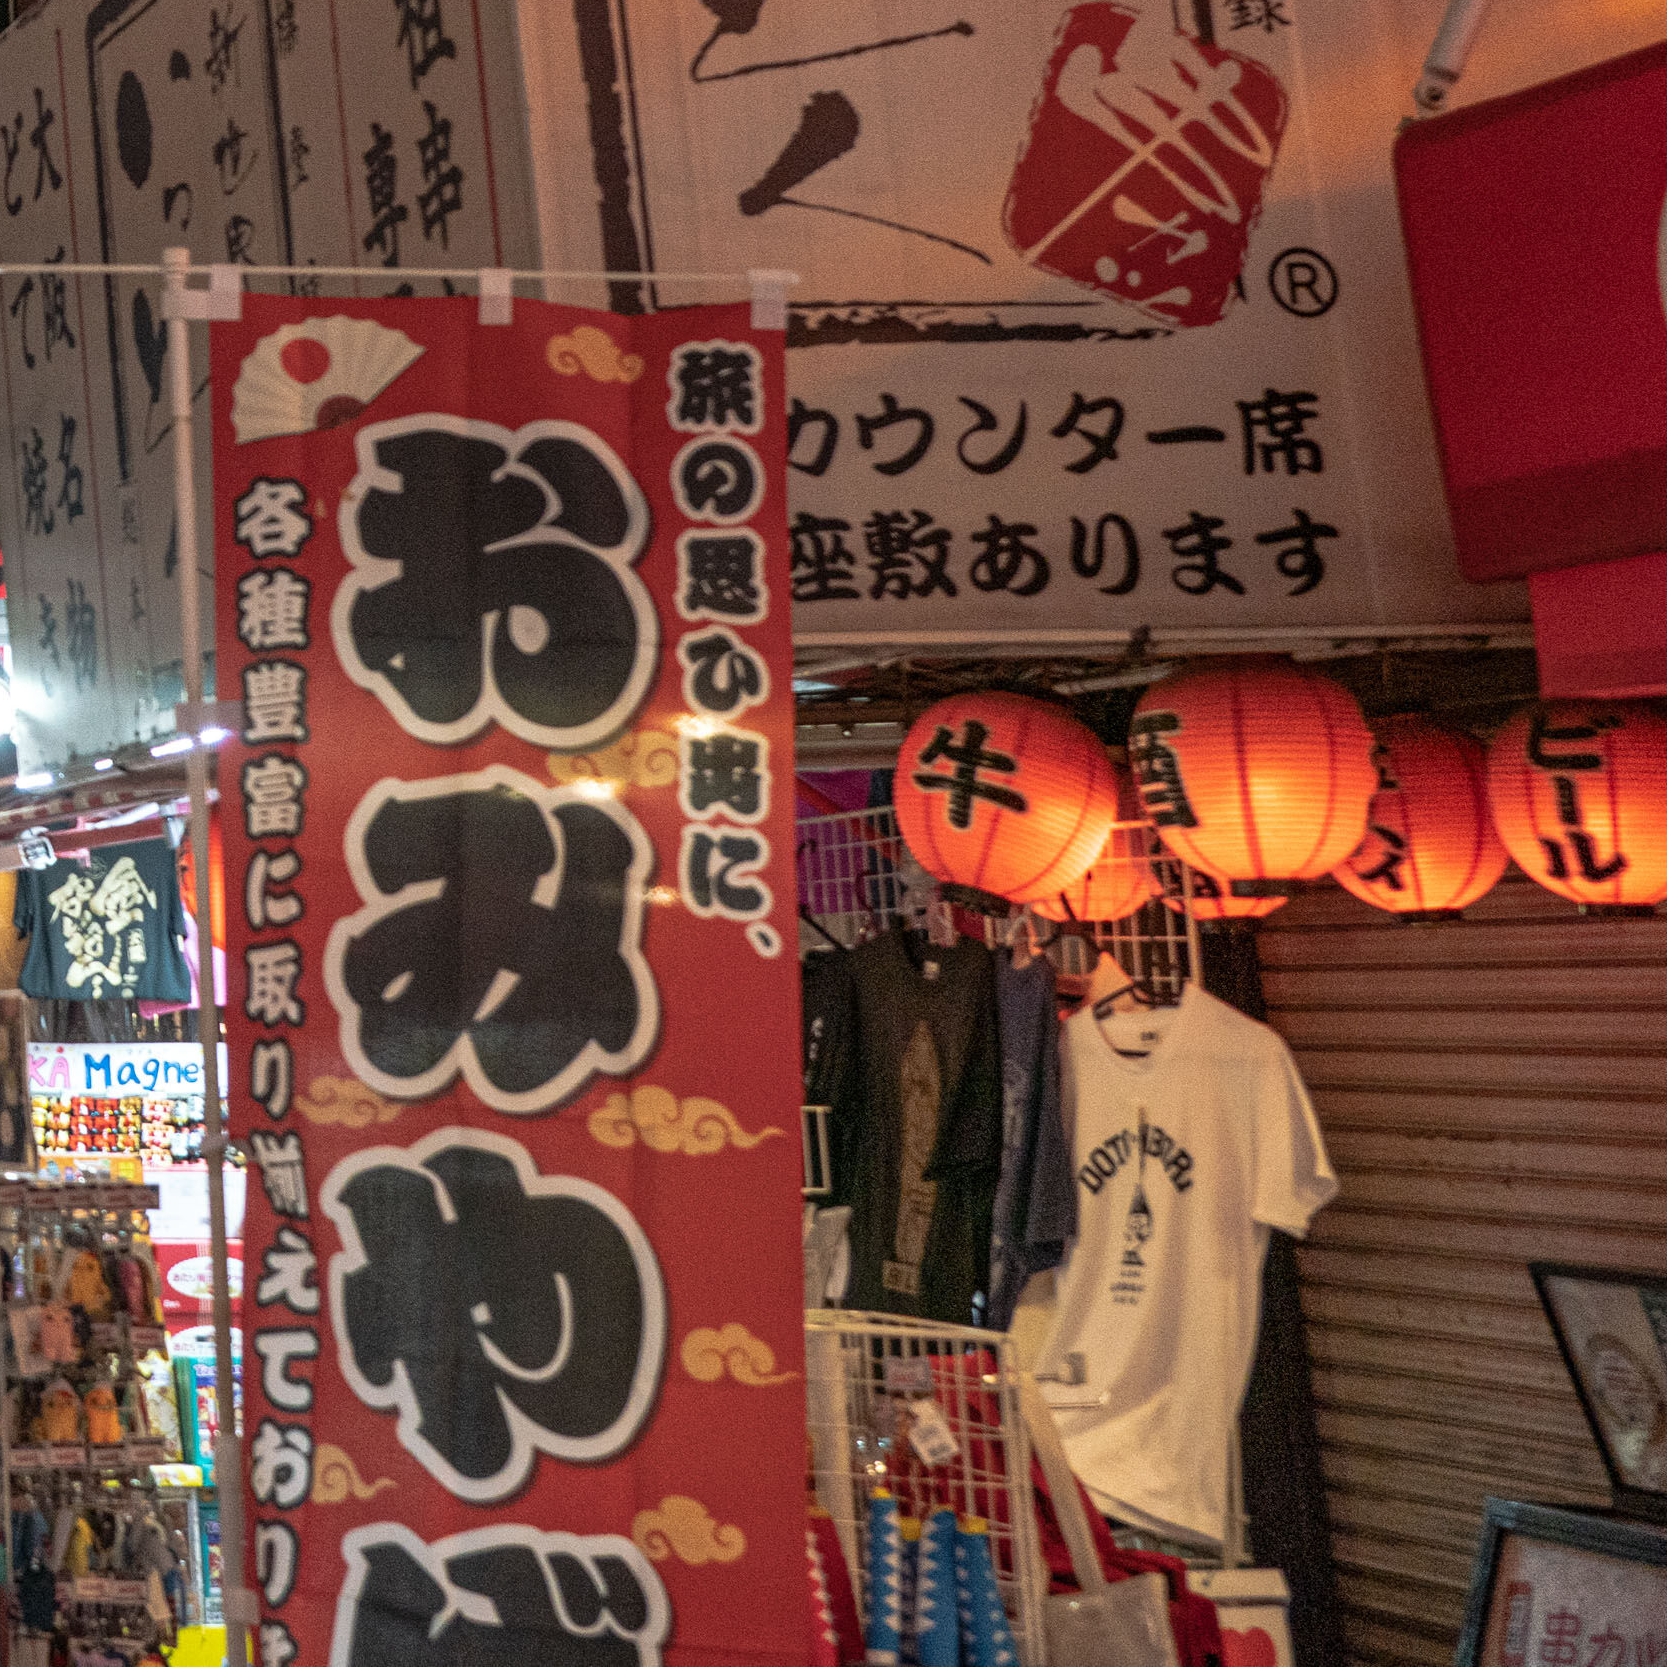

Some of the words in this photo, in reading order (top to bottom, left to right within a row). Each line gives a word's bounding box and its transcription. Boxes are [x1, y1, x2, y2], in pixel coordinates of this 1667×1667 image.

[790, 509, 1341, 600] 座敷あります
[912, 717, 1029, 831] 牛
[83, 1053, 202, 1091] Magne
